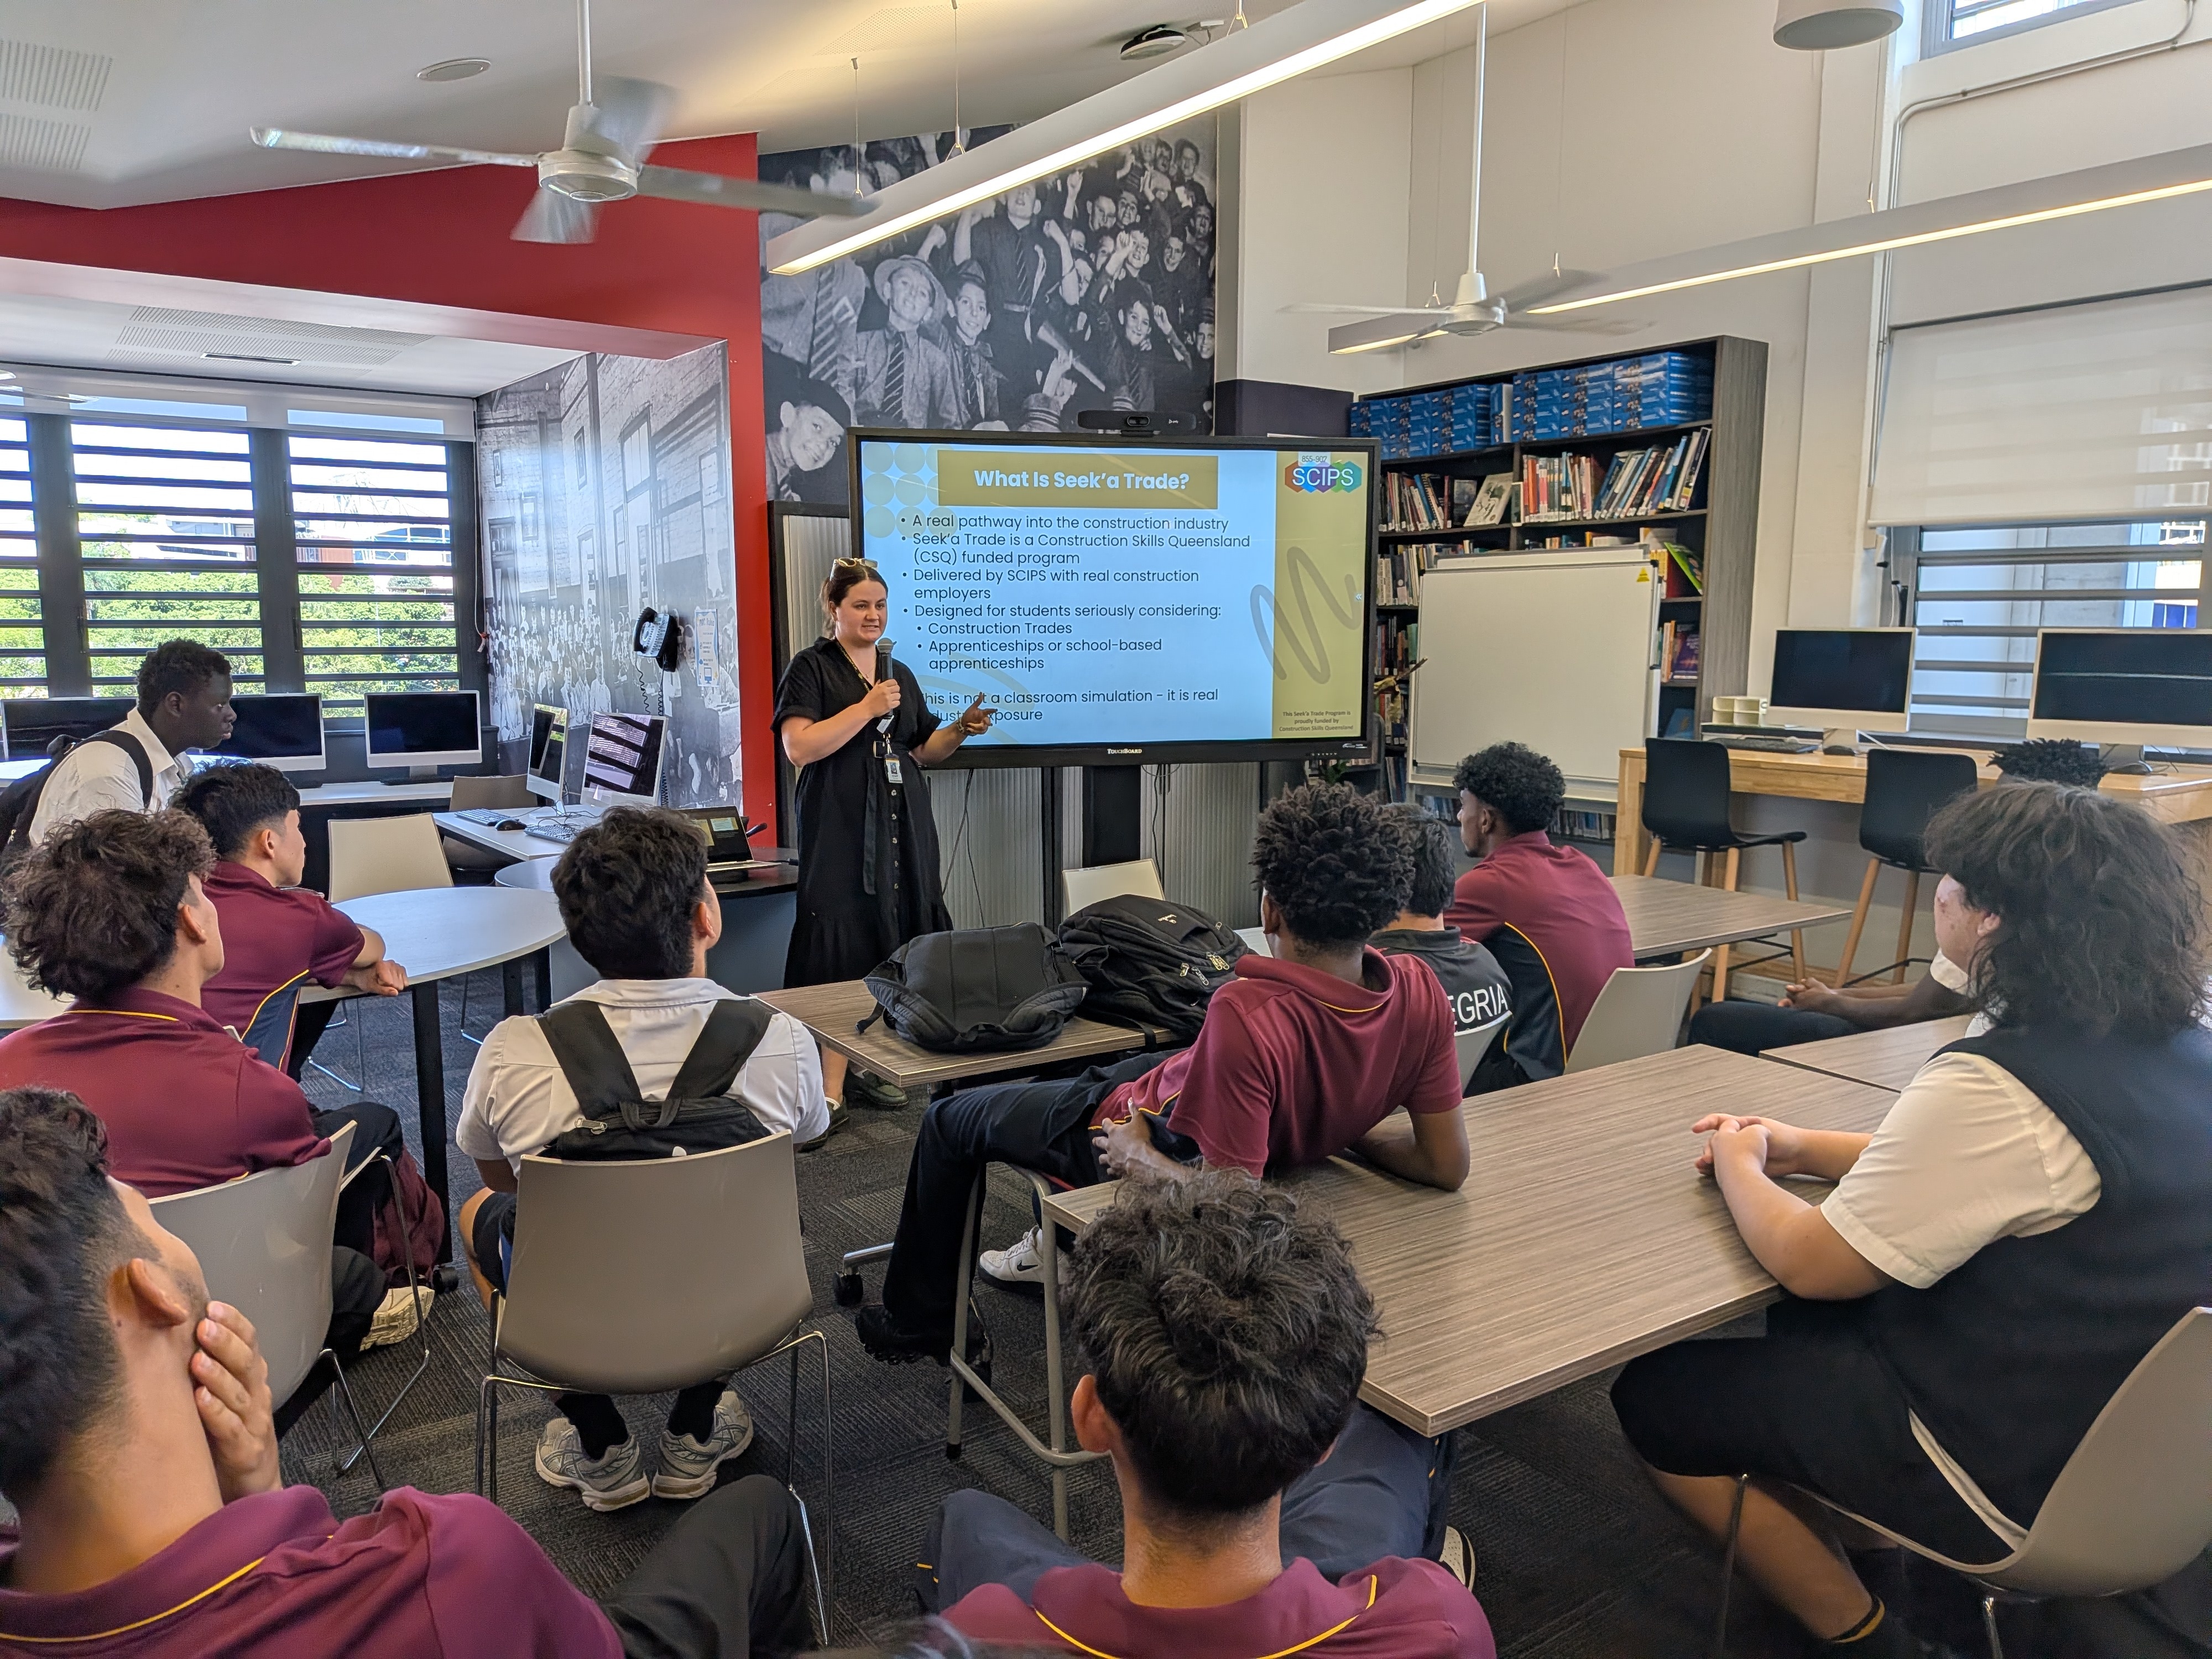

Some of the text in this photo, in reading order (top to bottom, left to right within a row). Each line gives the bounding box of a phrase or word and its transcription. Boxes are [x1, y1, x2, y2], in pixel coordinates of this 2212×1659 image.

[974, 470, 1190, 489] What Is Seek'a Trade?
[1292, 468, 1354, 486] SCIPS
[913, 515, 1229, 534] A real pathway into the construction industry
[913, 532, 1250, 549] Seek'a Trade is a Construction Skills Queensland
[914, 548, 1079, 567] (CSQ) funded program
[914, 568, 1199, 585] Delivered by SCIPS with real construction
[914, 587, 991, 602] employers
[915, 604, 1221, 620] Designed for students seriously considering:
[928, 622, 1072, 634] Construction Trades
[928, 638, 1162, 655] Apprenticeships or school-based
[929, 657, 1044, 673] apprenticeships
[923, 692, 945, 705] his
[949, 692, 959, 705] is
[990, 694, 1000, 704] a
[1004, 691, 1077, 704] classroom
[1081, 690, 1152, 702] simulation
[1167, 689, 1176, 701] it
[1179, 688, 1190, 701] is
[1193, 688, 1218, 701] real
[988, 709, 1043, 724] xposure
